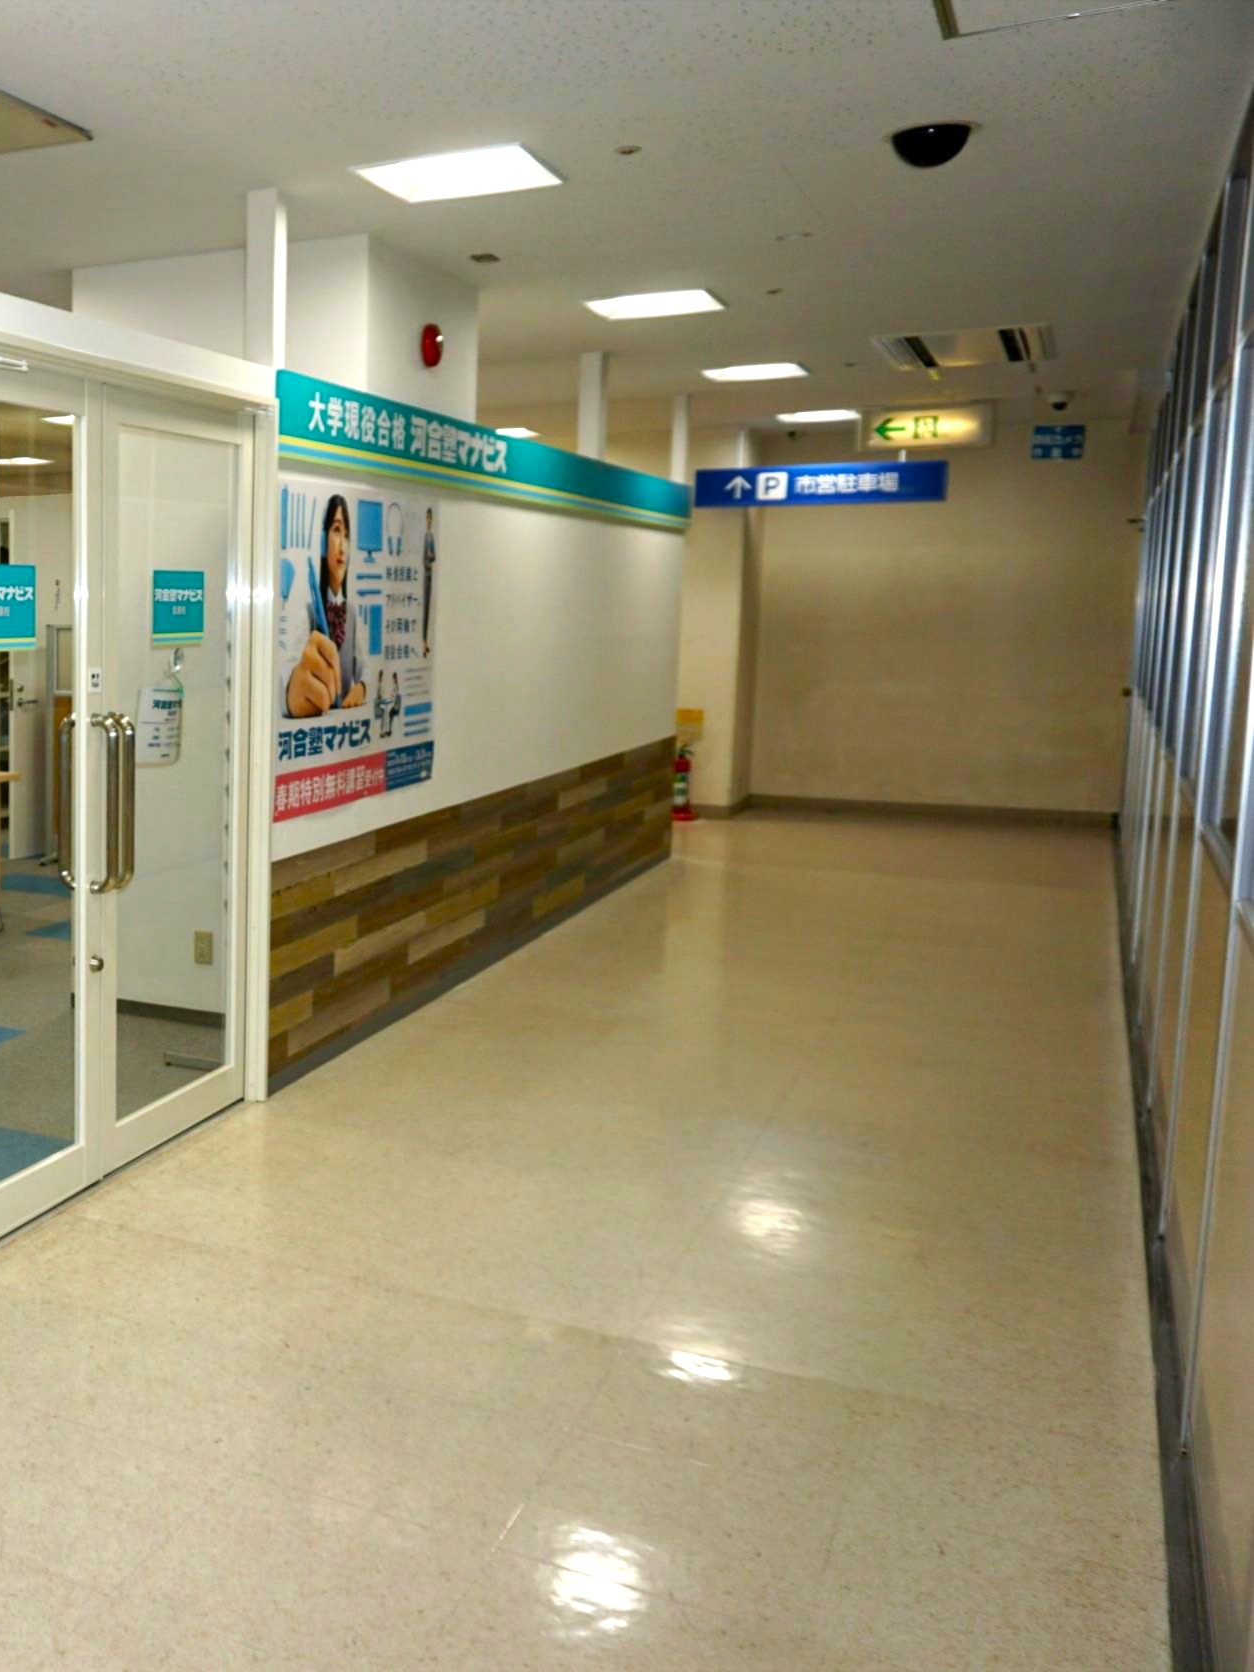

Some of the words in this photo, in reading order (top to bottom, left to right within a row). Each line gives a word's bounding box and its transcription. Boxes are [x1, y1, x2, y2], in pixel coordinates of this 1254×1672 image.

[308, 391, 407, 451] 大学現役合格
[410, 415, 507, 474] 河合塾マナビス
[794, 471, 900, 495] 市営駐車場
[154, 588, 203, 601] 河合塾マナビス
[279, 719, 371, 761] 河合塾マナビス
